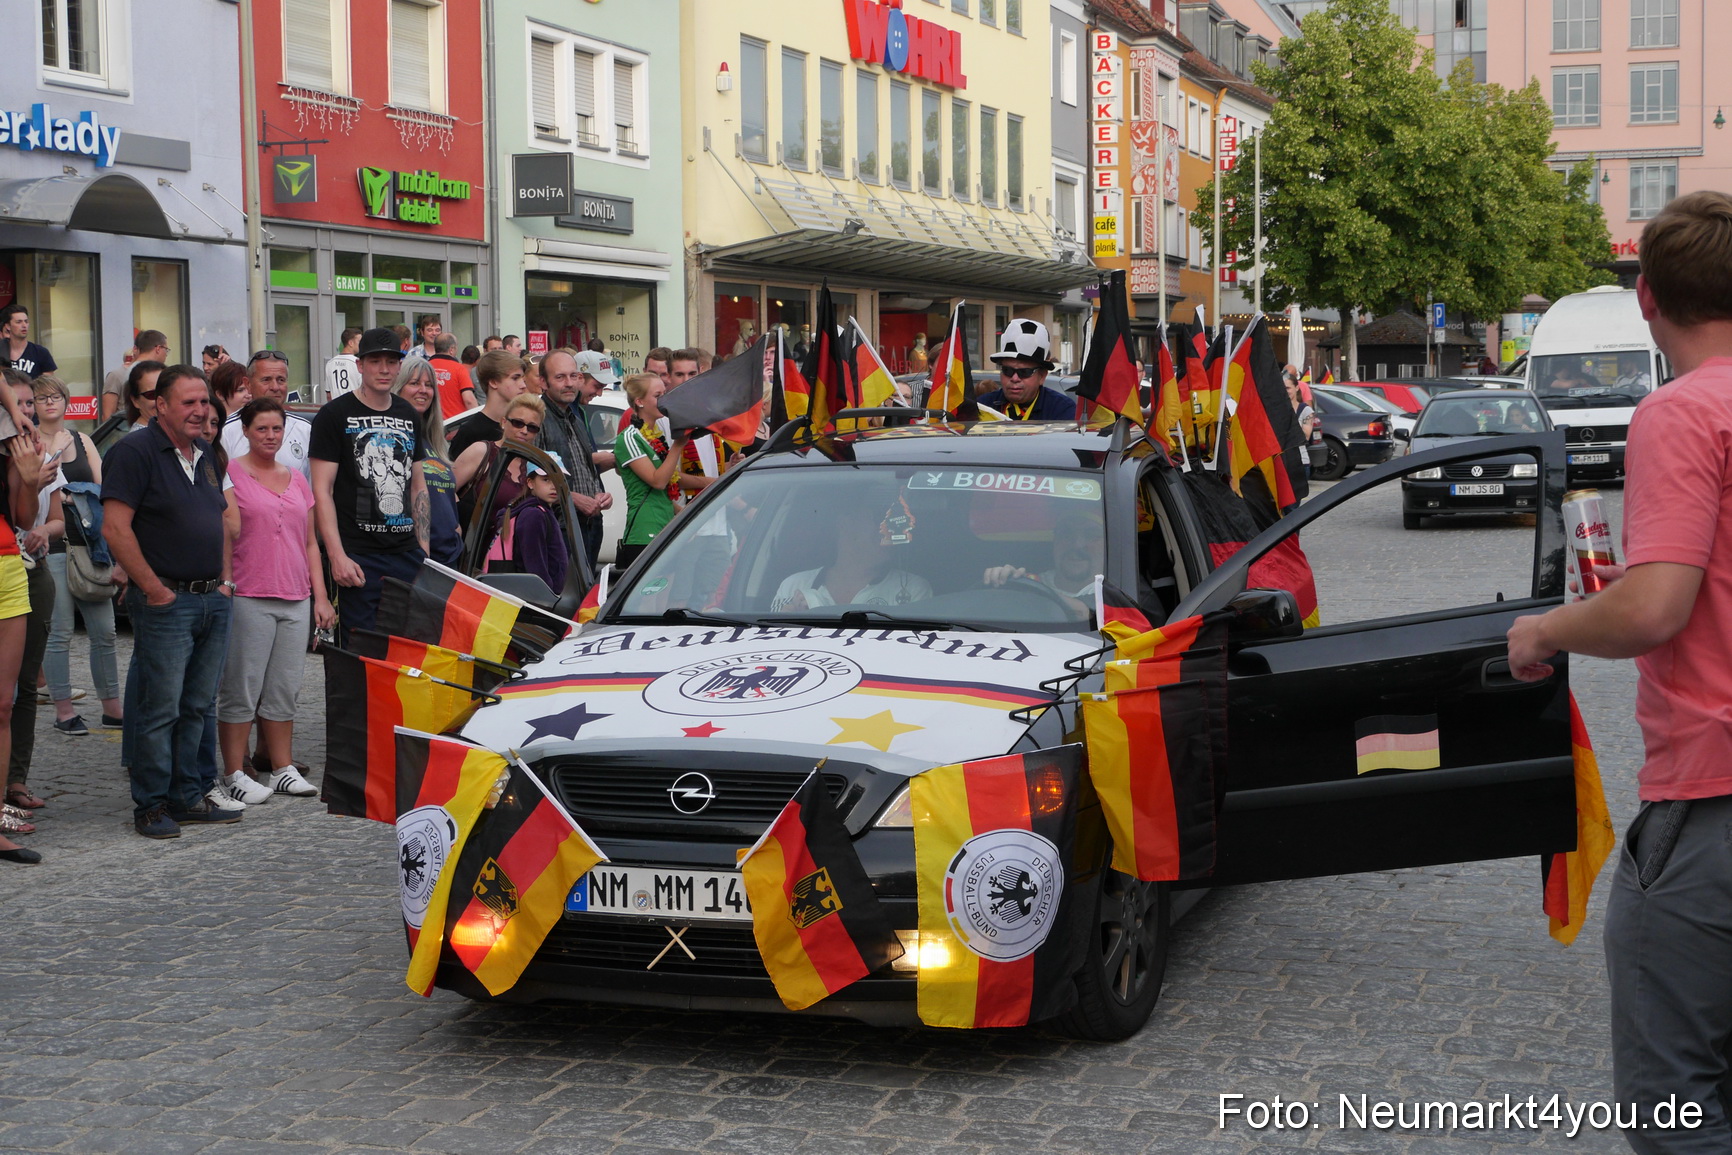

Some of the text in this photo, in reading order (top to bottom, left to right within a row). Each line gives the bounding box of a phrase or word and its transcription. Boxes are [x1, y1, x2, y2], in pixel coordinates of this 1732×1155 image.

[1096, 34, 1113, 210] BÄCKEREI
[40, 103, 121, 168] lady
[398, 169, 471, 200] mobilcom
[398, 197, 443, 225] debitel
[1095, 218, 1116, 231] café
[1095, 242, 1116, 254] plank
[336, 276, 366, 291] GRAVIS
[1435, 306, 1443, 325] P
[333, 369, 349, 389] 18
[346, 415, 414, 432] STEREO
[953, 472, 1055, 493] BOMBA
[1458, 484, 1500, 494] NM JS 80
[678, 652, 852, 677] DEUTSCHLAND
[573, 892, 582, 903] D
[589, 871, 628, 908] NM
[654, 874, 694, 911] MM
[1031, 857, 1052, 926] DEUTSCHER
